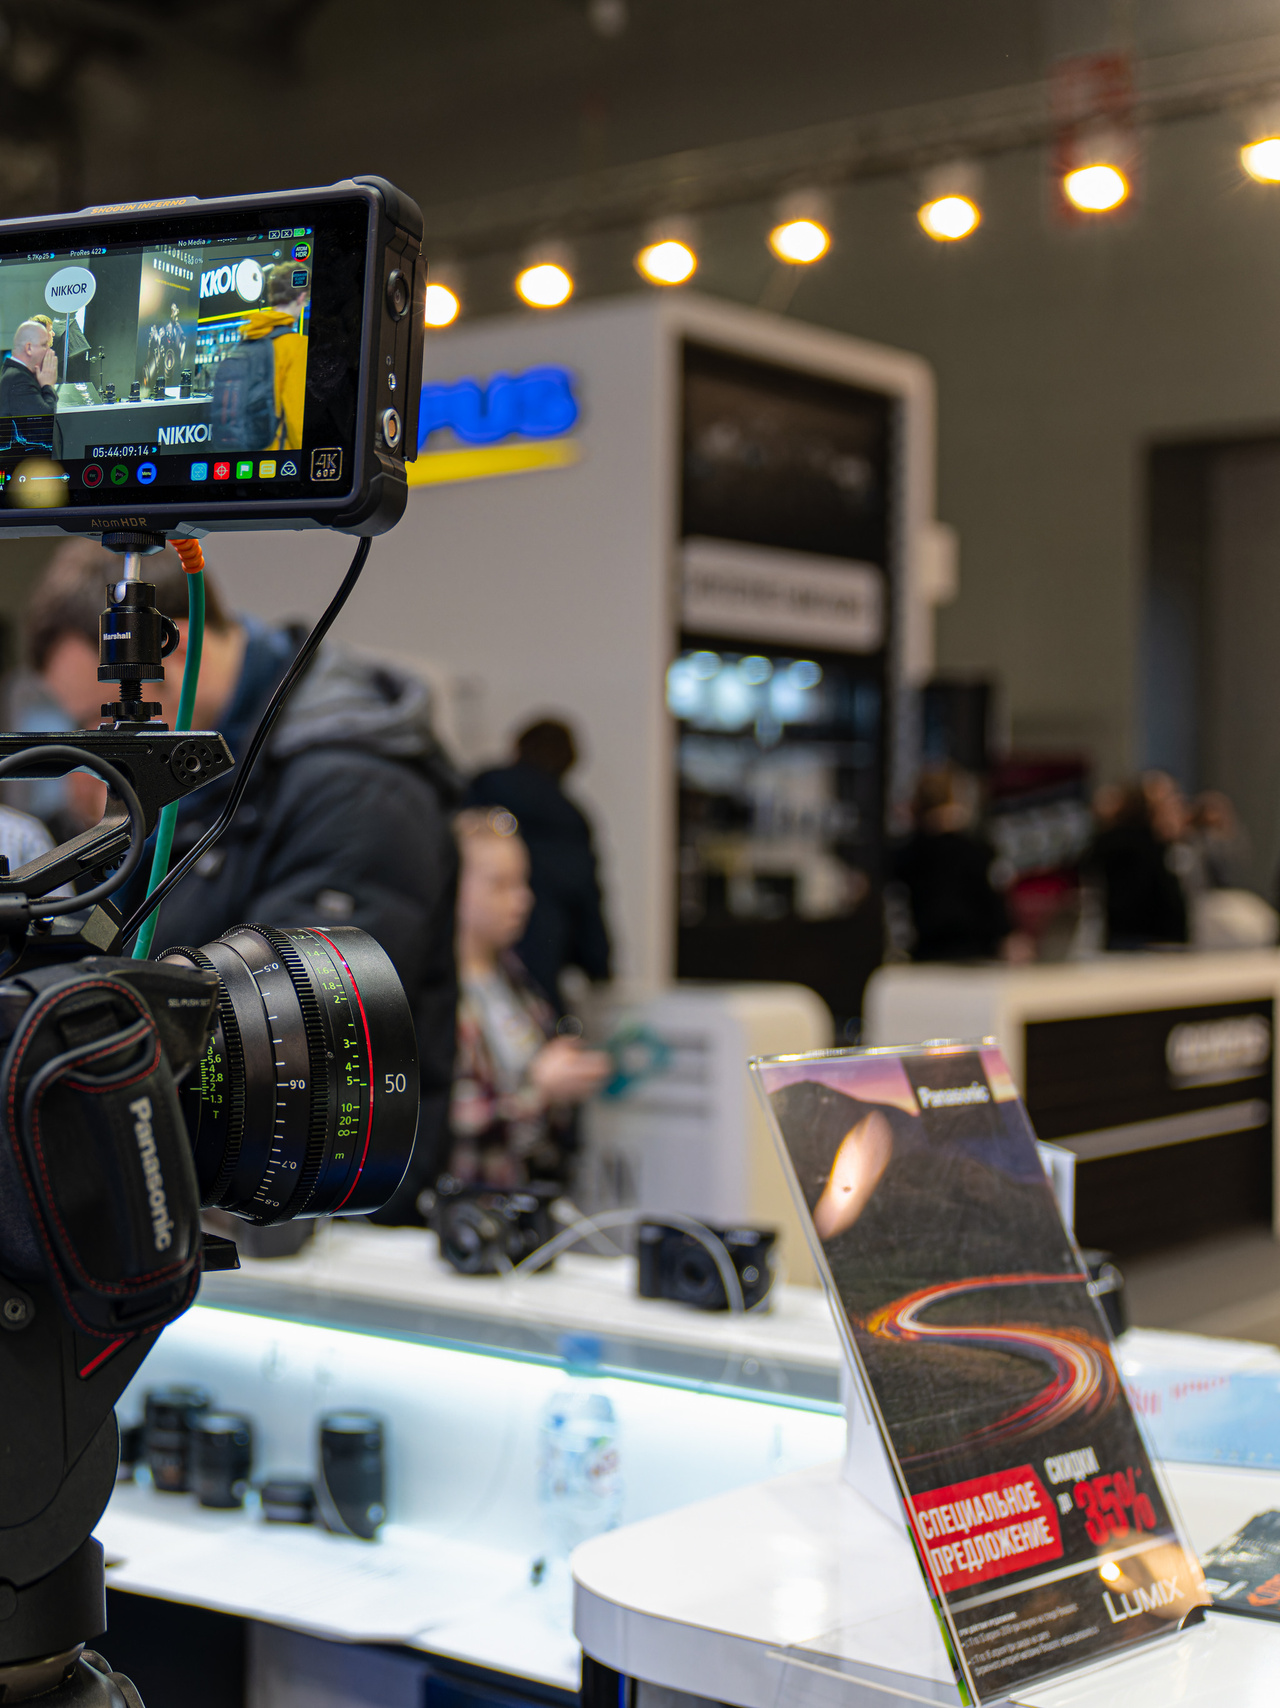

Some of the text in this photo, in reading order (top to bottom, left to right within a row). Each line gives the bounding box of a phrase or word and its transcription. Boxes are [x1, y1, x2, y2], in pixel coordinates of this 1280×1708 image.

[91, 199, 187, 214] SHOGUN INFERNO
[188, 238, 206, 246] Media
[153, 258, 194, 281] REINVENTED
[51, 283, 88, 297] NIKKOR
[92, 445, 149, 458] 05:44:09:14
[315, 453, 338, 469] 4K
[316, 469, 336, 478] 60P
[91, 517, 148, 528] AtomHDR
[103, 632, 131, 641] Marshall
[316, 966, 330, 975] 1.6
[322, 982, 336, 990] 1.8
[333, 995, 341, 1004] 2
[343, 1038, 350, 1049] 3
[207, 1054, 222, 1064] 5.6
[345, 1062, 352, 1071] 4
[209, 1072, 224, 1082] 2.8
[346, 1075, 353, 1086] 5
[385, 1073, 407, 1094] 50
[210, 1094, 223, 1104] 1.3
[917, 1081, 989, 1109] Panasonic
[341, 1103, 353, 1113] 10
[339, 1115, 352, 1126] 20
[335, 1152, 345, 1160] m
[129, 1096, 175, 1252] Panasonic
[918, 1480, 1042, 1540] СПЕЦИАЛЬНОЕ
[930, 1516, 1055, 1578] ПРЕДЛОЖЕНИЕ
[1102, 1576, 1185, 1623] LUMIX
